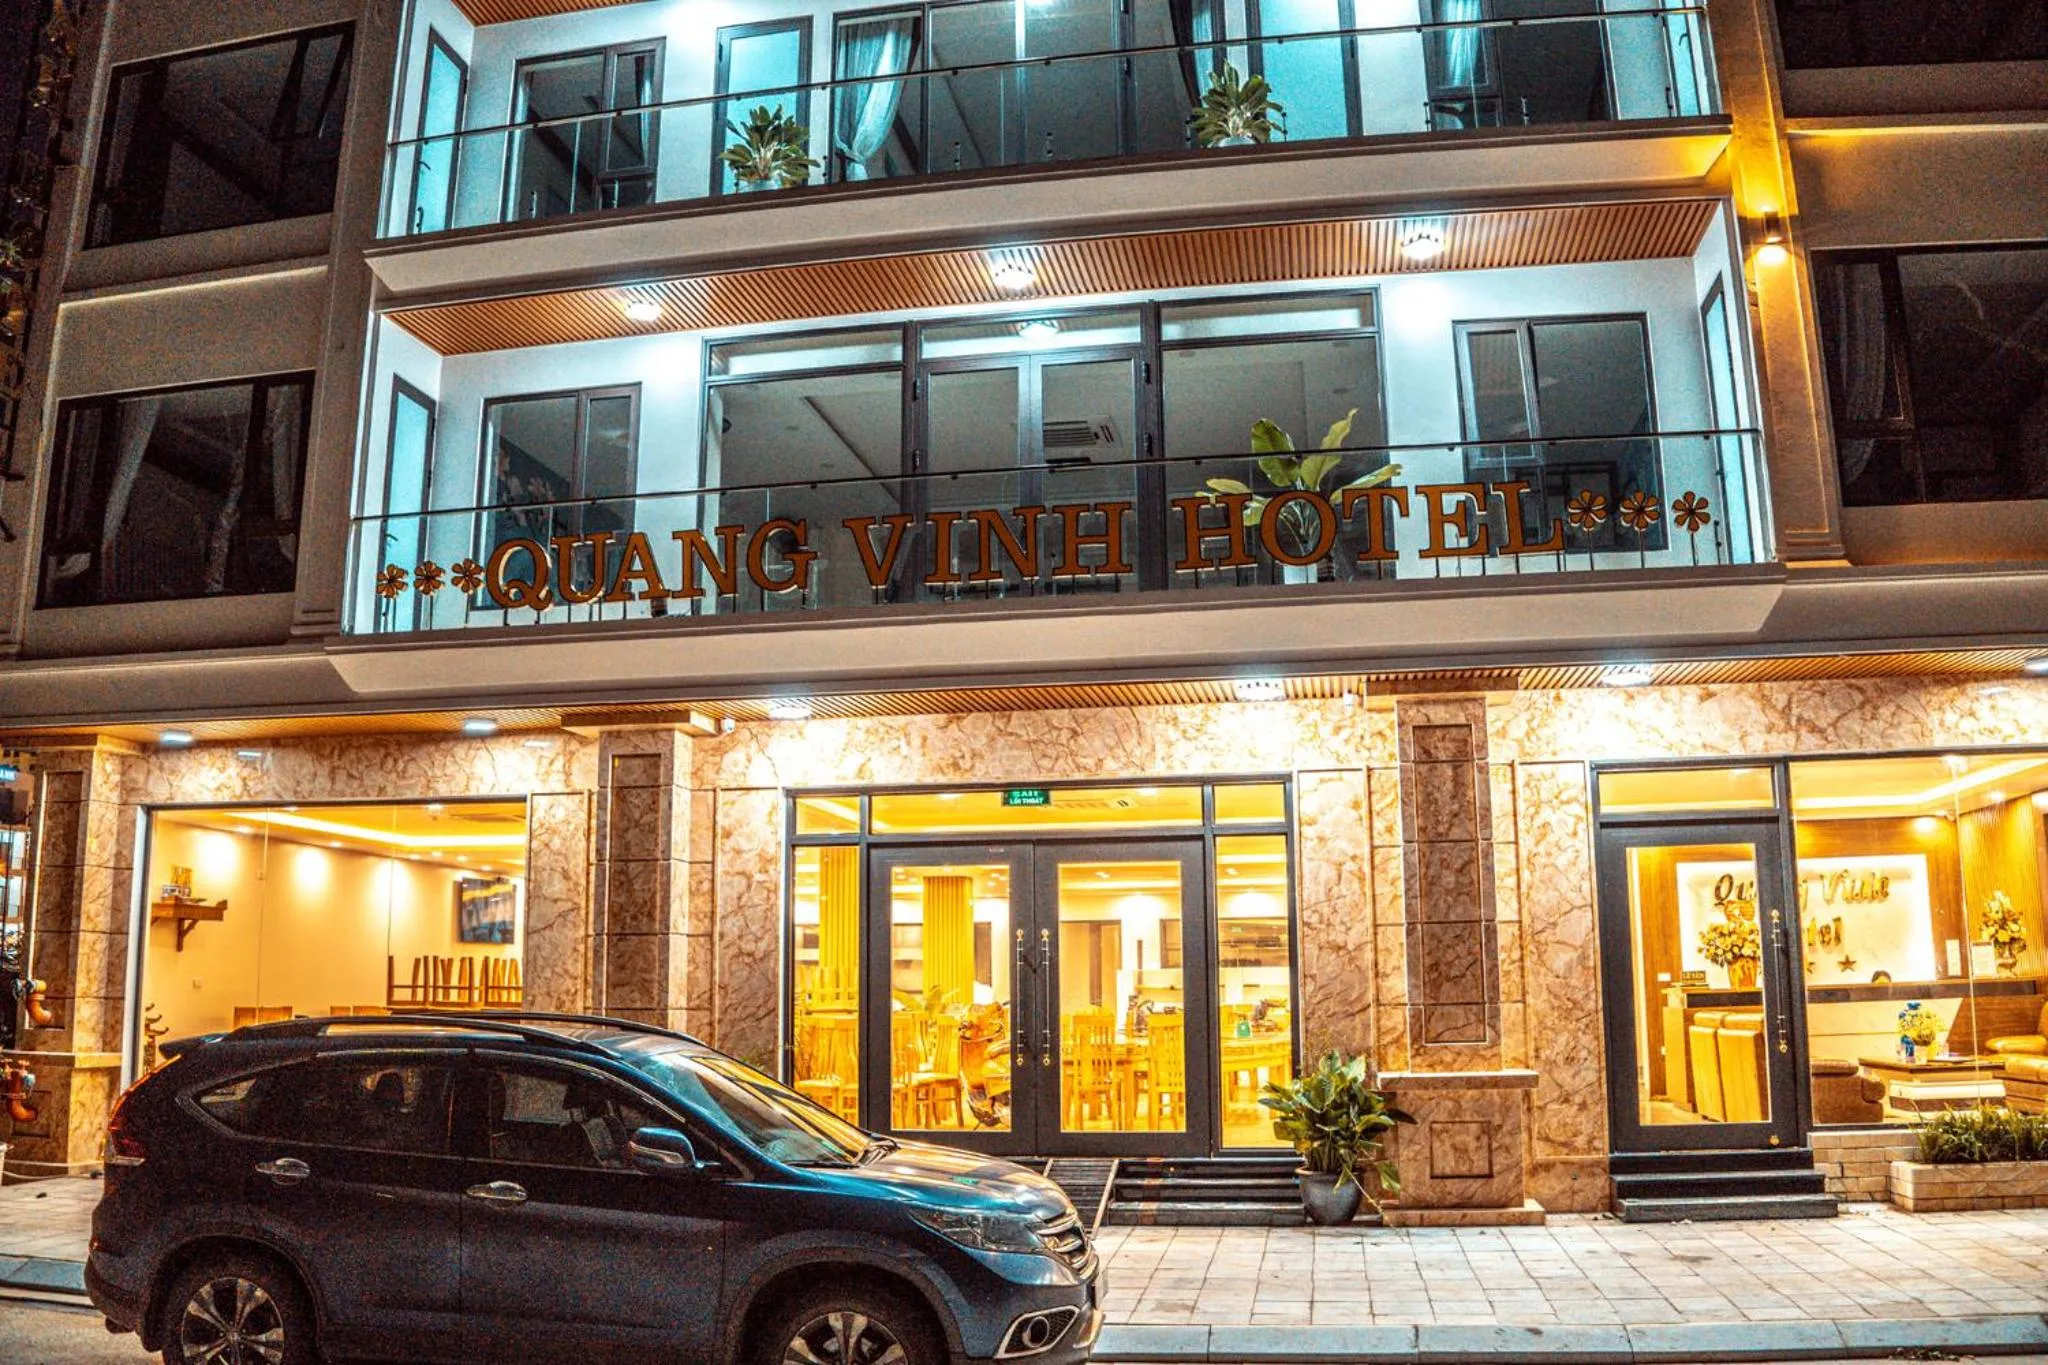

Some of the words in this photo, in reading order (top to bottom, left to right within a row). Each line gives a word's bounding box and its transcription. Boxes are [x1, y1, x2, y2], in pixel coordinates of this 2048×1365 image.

[486, 515, 818, 611] QUANG
[842, 502, 1133, 589] VINH
[1172, 480, 1566, 570] HOTEL
